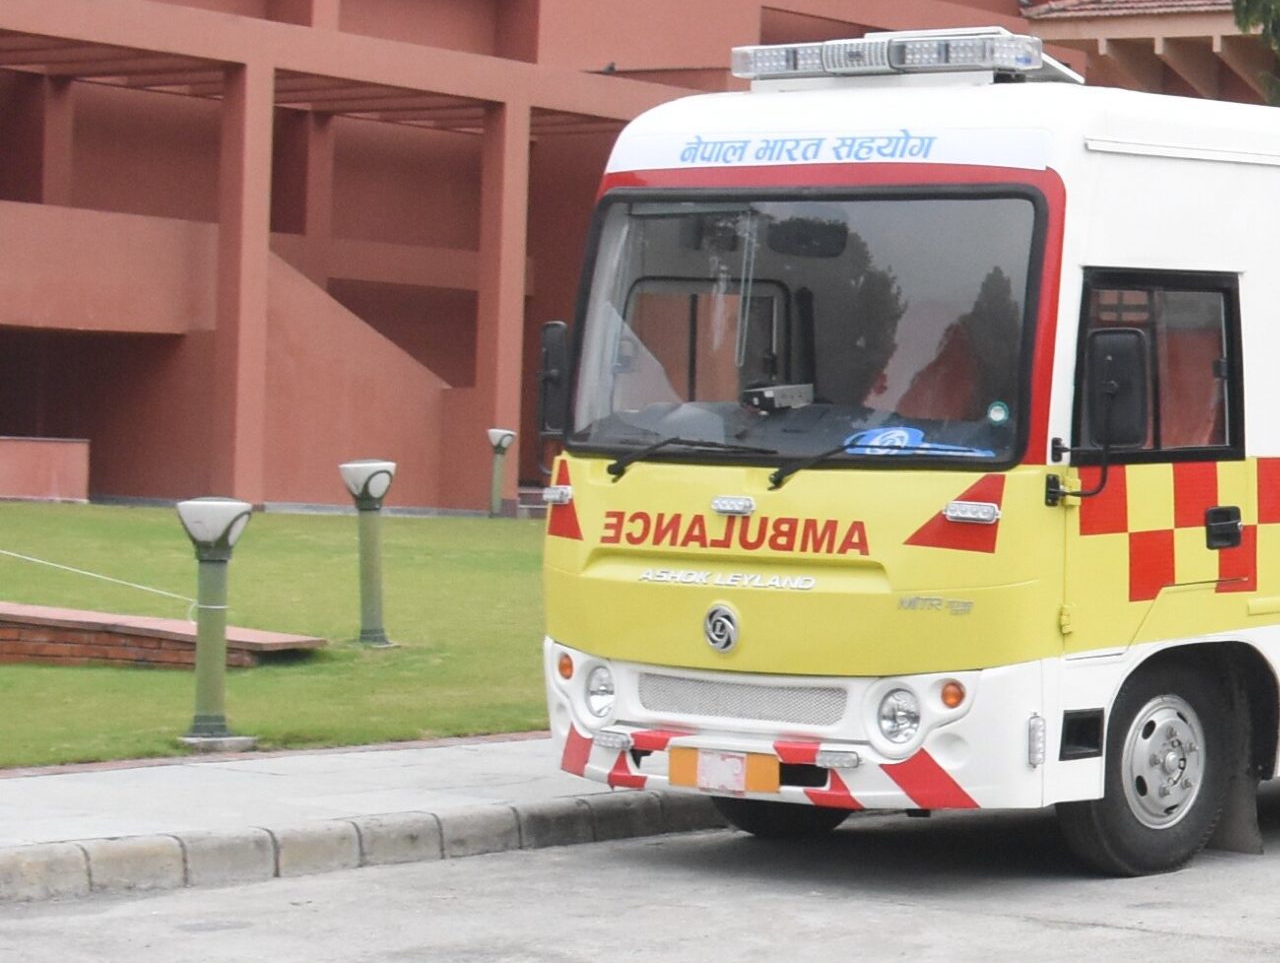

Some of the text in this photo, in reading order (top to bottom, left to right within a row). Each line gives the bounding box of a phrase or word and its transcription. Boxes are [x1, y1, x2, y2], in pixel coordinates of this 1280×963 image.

[679, 129, 937, 164] नेपाल भारत सहयोग
[638, 568, 816, 590] ASHOK LEYLAND
